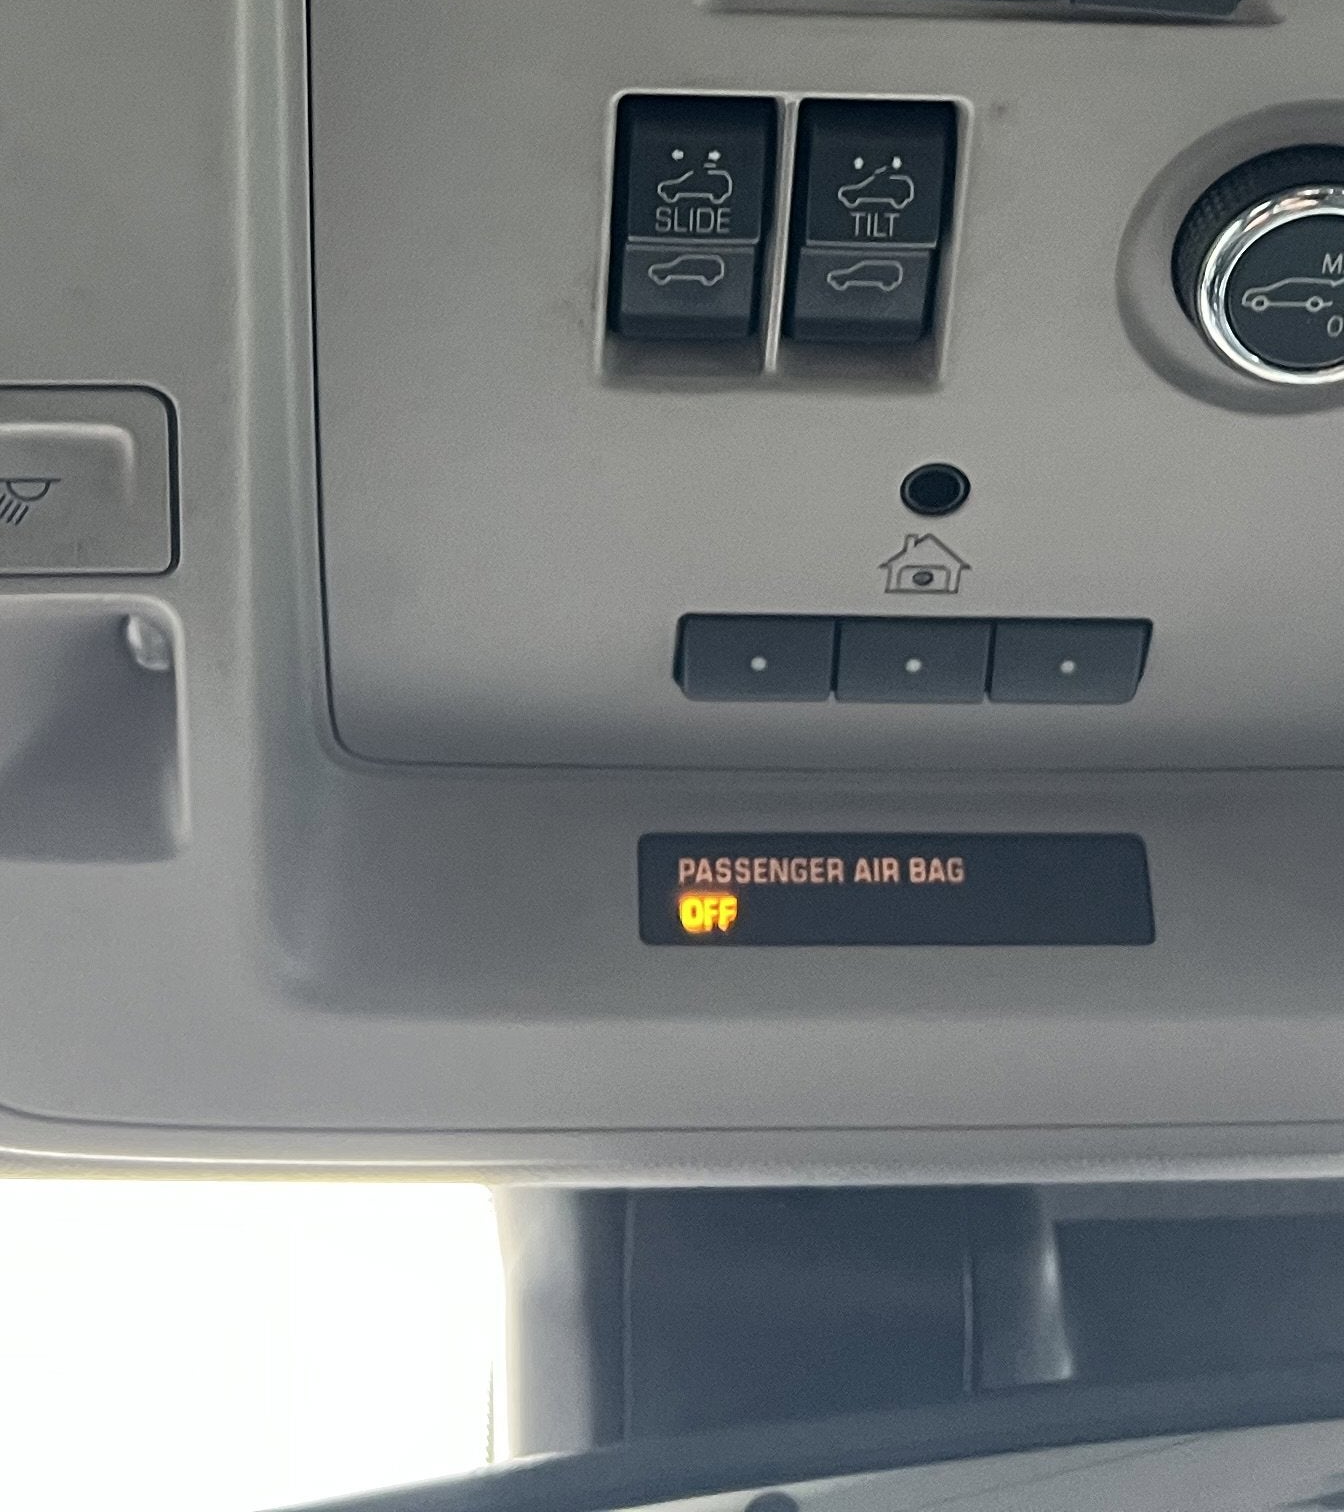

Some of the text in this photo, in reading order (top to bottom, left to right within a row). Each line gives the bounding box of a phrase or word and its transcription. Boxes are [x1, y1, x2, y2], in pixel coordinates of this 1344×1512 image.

[655, 207, 731, 233] SLIDE
[851, 212, 900, 237] TILT
[678, 857, 965, 885] PASSENGER AIR BAG
[679, 894, 738, 932] OFF
